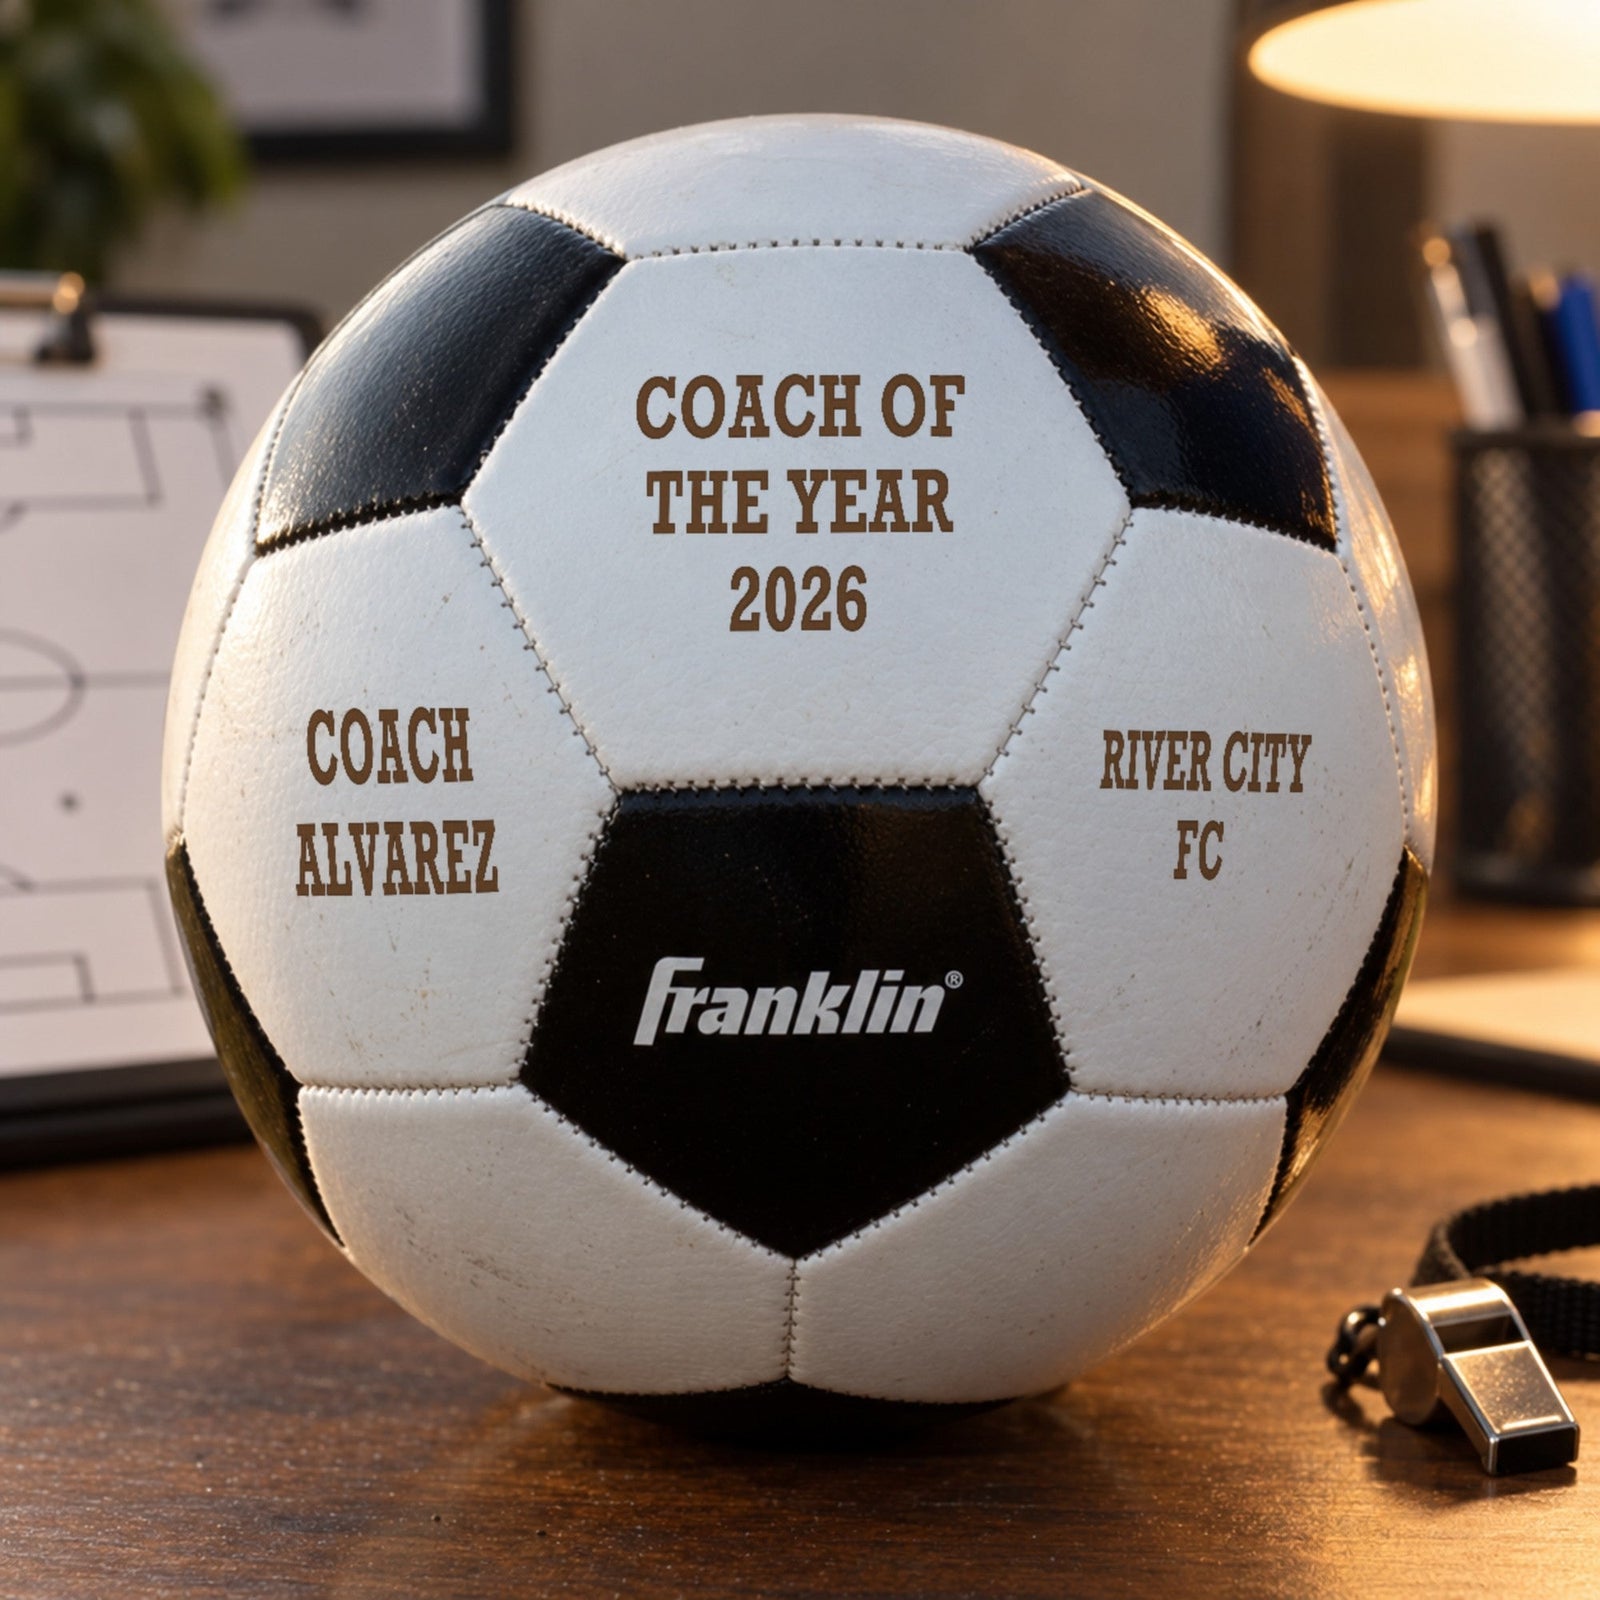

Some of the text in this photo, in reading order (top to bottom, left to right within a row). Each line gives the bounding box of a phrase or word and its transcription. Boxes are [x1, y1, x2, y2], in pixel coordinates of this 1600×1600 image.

[636, 374, 965, 439] COACH OF
[647, 469, 953, 534] THE YEAR
[730, 565, 867, 632] 2026
[307, 707, 474, 786] COACH
[1100, 730, 1312, 793] RIVER CITY
[296, 820, 499, 896] ALVAREZ
[1173, 820, 1224, 880] FC
